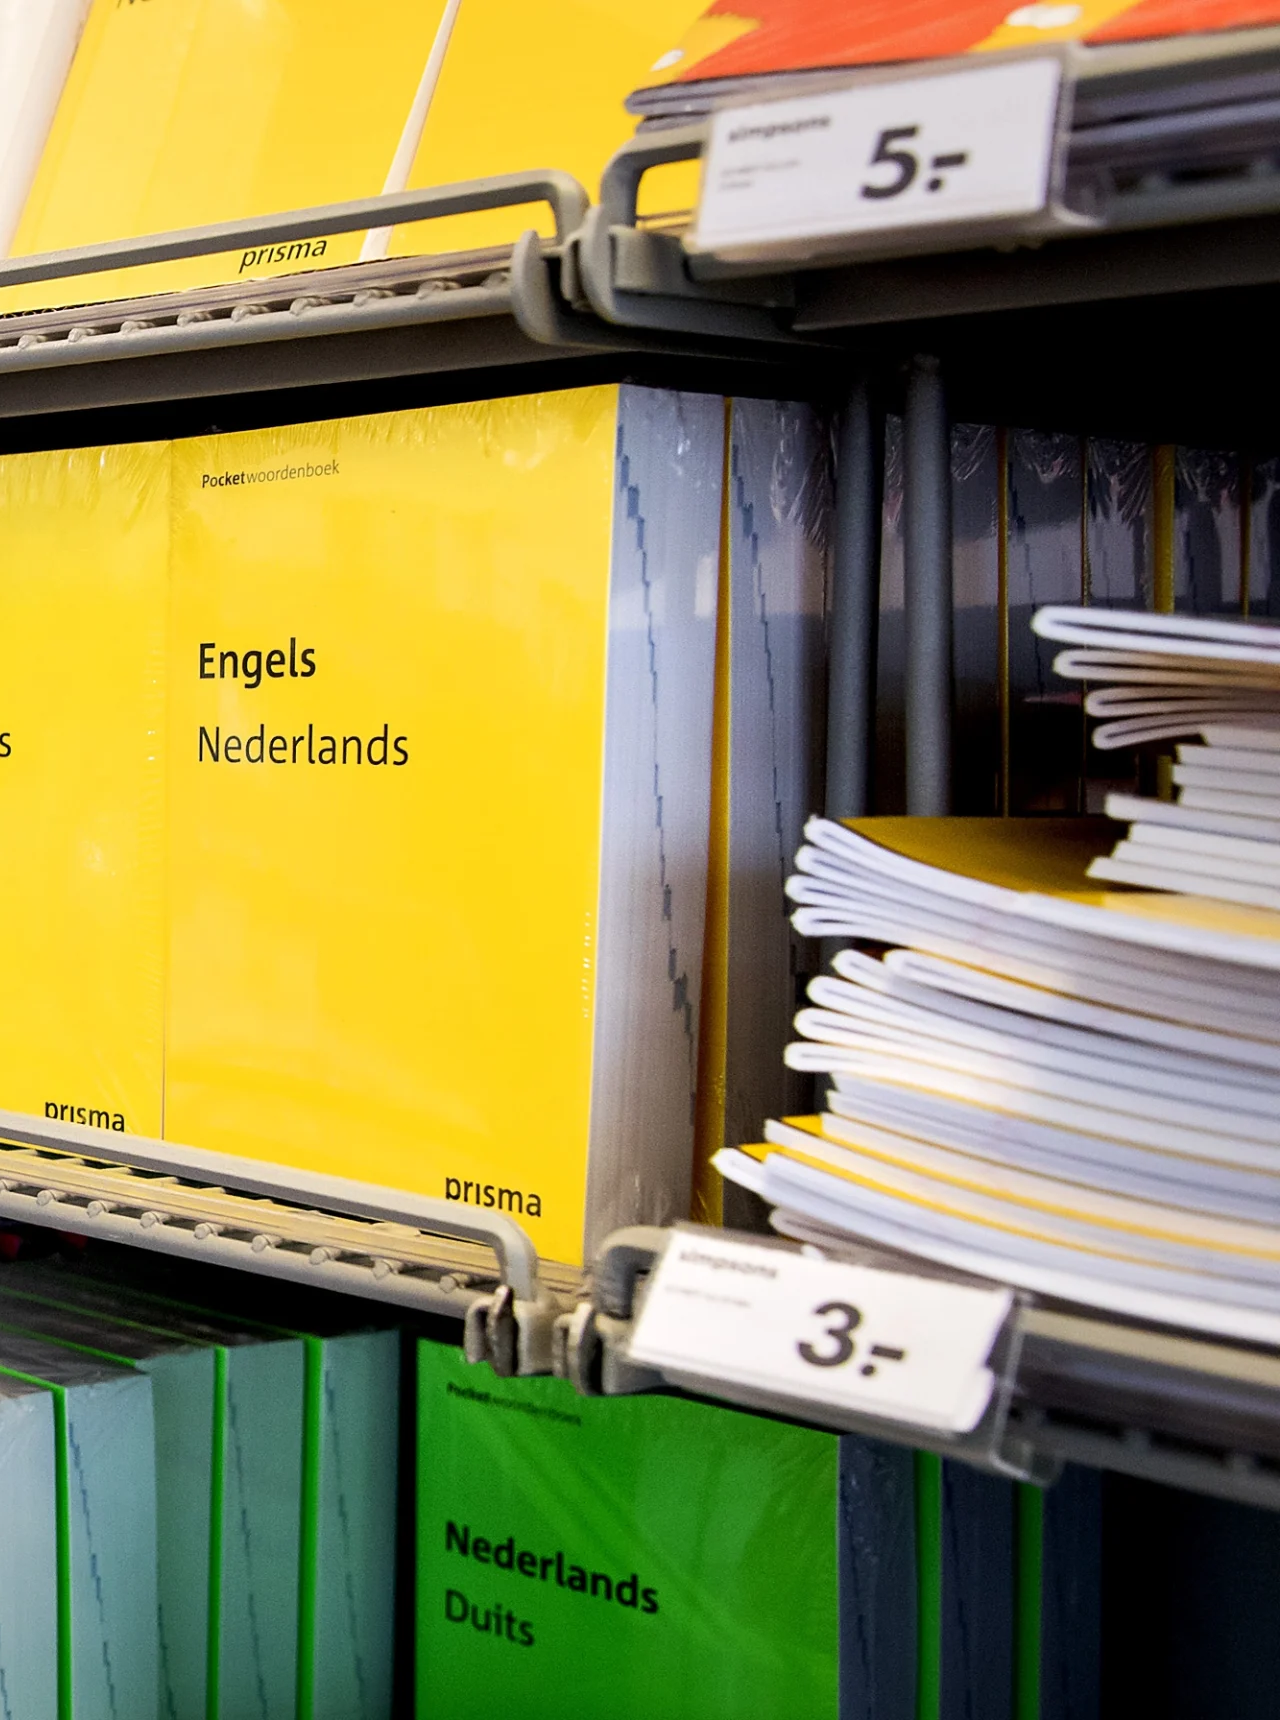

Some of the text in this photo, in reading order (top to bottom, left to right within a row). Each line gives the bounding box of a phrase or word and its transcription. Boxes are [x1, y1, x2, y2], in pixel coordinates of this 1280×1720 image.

[239, 239, 328, 273] prisma
[202, 460, 340, 489] Pocketwoordenboek
[199, 638, 317, 689] Engels
[198, 724, 409, 766] Nederlands
[446, 1521, 660, 1614] Nederlands
[446, 1589, 535, 1648] Duits
